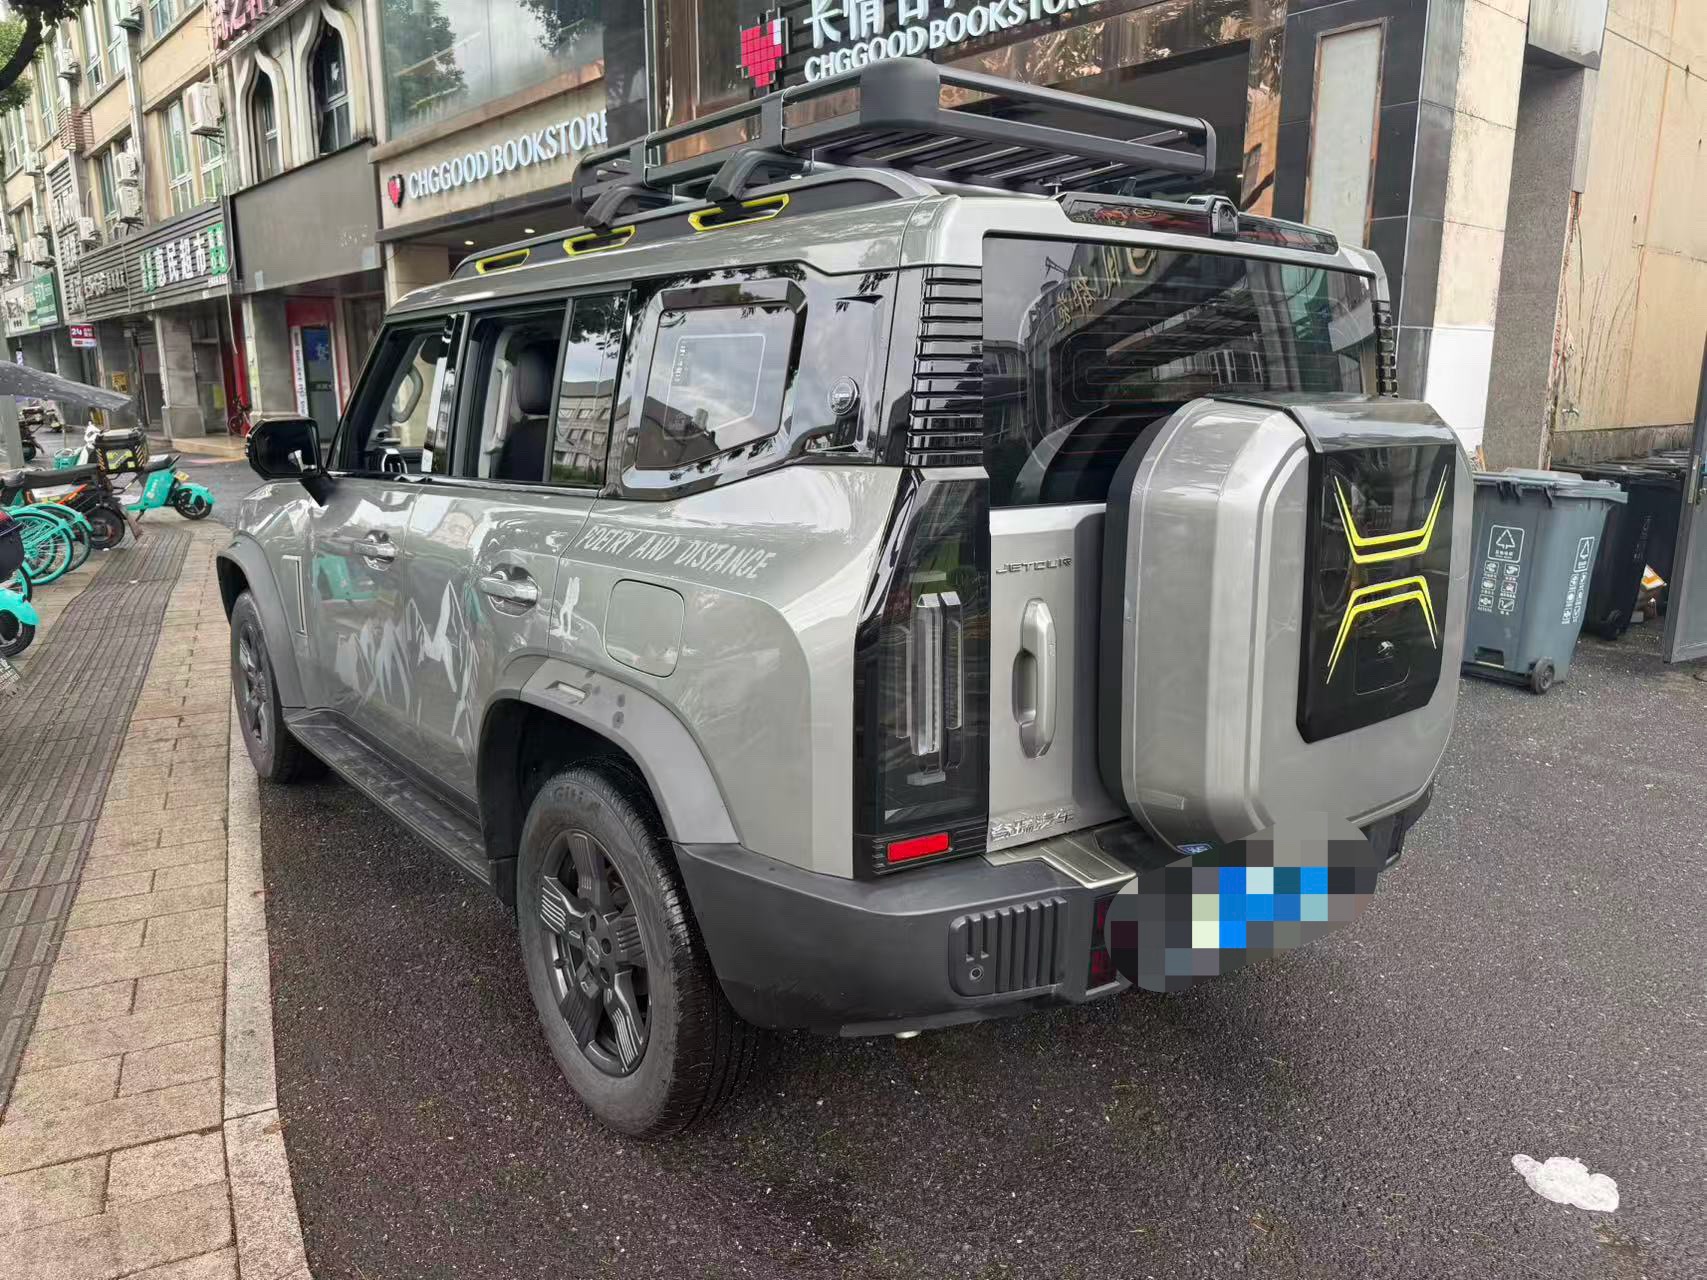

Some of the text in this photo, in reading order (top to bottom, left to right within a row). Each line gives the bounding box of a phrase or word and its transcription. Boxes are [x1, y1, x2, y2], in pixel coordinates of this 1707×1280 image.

[804, 0, 1100, 83] CHGGOOD BOOKST
[407, 150, 489, 199] CHGGOOD
[628, 534, 681, 562] AND
[673, 540, 777, 579] DISTANCE
